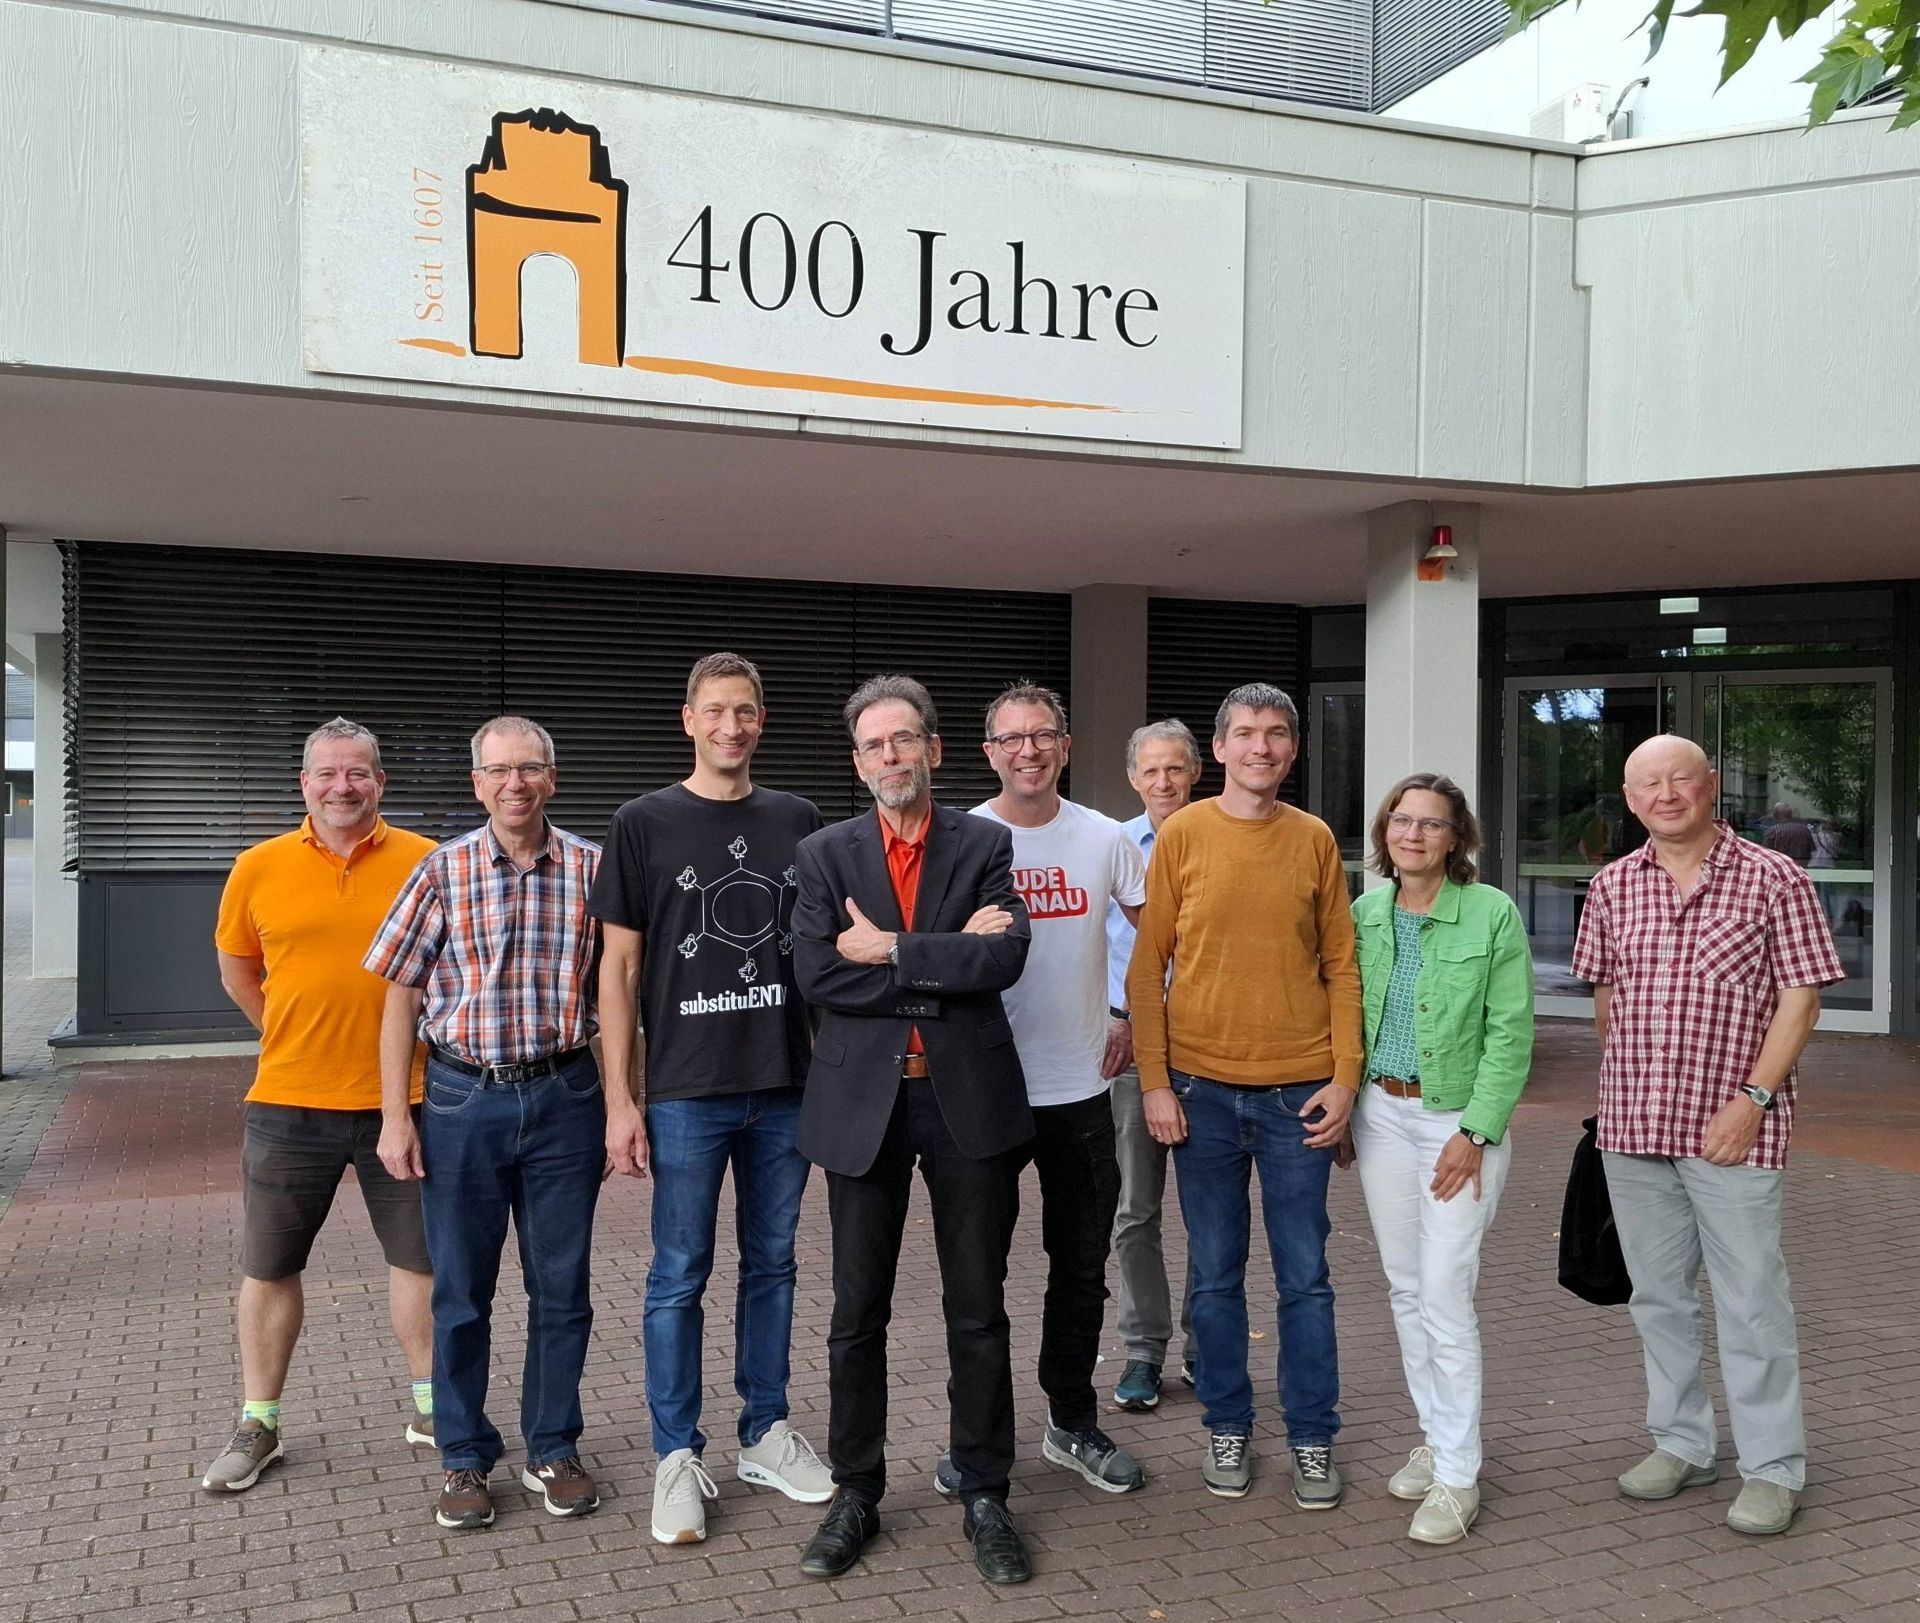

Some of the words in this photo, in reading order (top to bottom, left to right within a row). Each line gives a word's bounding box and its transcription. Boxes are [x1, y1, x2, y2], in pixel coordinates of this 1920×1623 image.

[413, 167, 443, 245] 1607
[413, 259, 444, 322] Seit
[666, 204, 864, 318] 400
[880, 228, 1159, 356] Jahre
[1019, 888, 1083, 914] NAU
